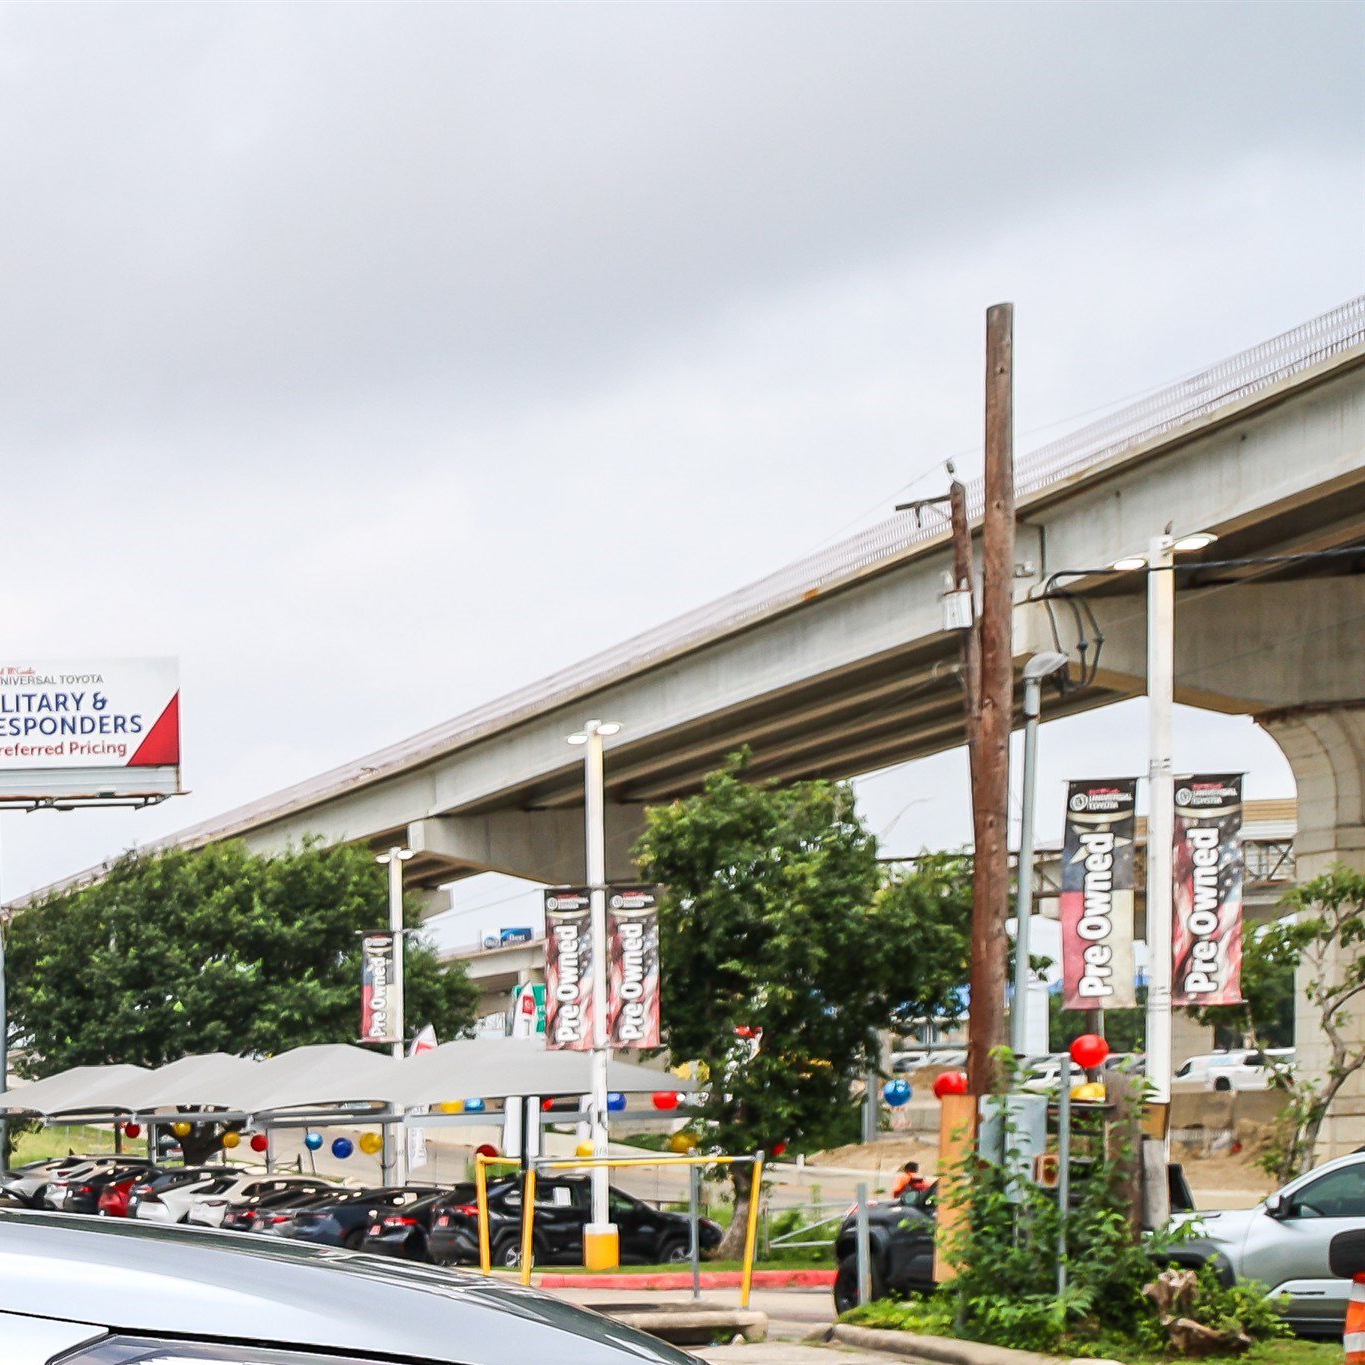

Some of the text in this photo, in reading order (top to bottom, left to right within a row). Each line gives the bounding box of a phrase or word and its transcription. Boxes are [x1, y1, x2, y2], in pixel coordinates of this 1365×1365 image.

[60, 674, 104, 685] TOYOTA
[92, 691, 108, 711] &
[69, 740, 128, 758] Pricing
[1076, 831, 1115, 941] Owned
[1186, 827, 1220, 936] Owned
[555, 925, 580, 1002] Owned
[618, 923, 644, 1000] Owned
[1077, 943, 1115, 998] Pre
[1185, 940, 1219, 993] Pre
[555, 1003, 581, 1043] Pre
[619, 1002, 645, 1041] Pre
